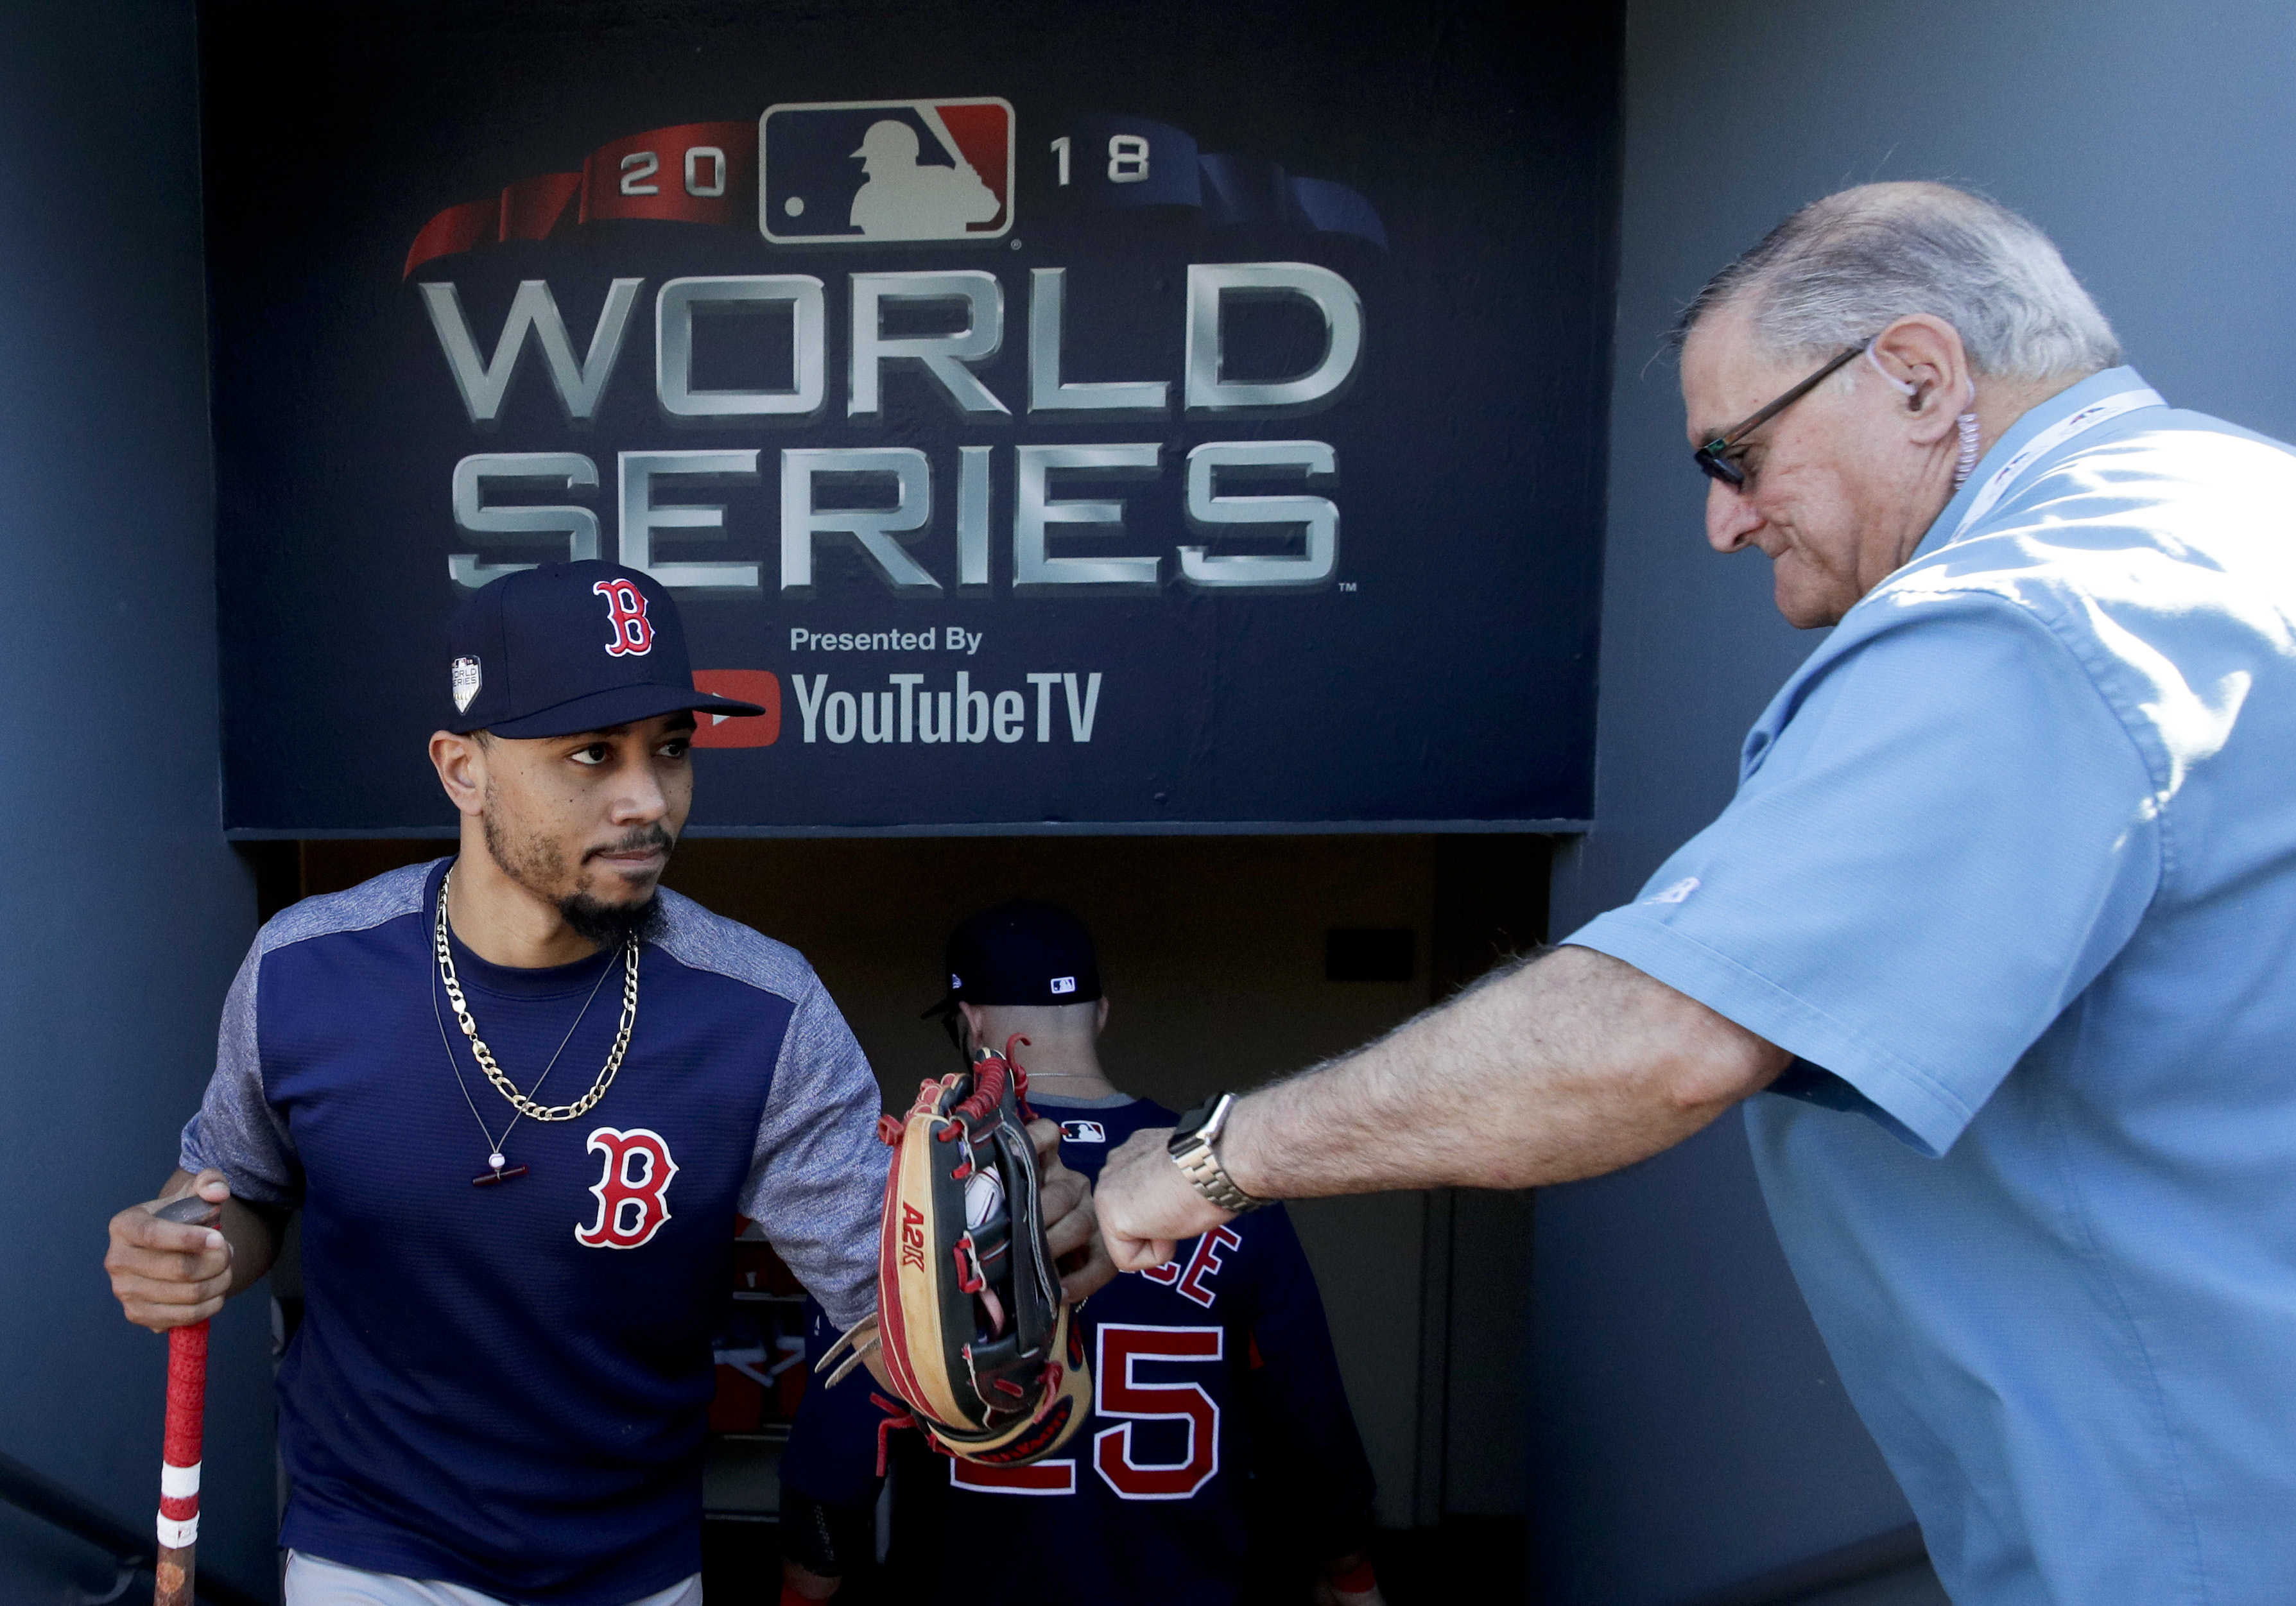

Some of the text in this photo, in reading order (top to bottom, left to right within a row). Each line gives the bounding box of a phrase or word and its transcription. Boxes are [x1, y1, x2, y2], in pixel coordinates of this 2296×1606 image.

[419, 261, 1362, 420] WORLD
[448, 440, 1339, 589] SERIES
[593, 578, 655, 657] B
[790, 626, 982, 655] Presented By
[453, 668, 477, 678] ORLD
[453, 677, 477, 687] ERIES
[574, 1127, 679, 1249] B
[902, 1200, 924, 1273] A2K
